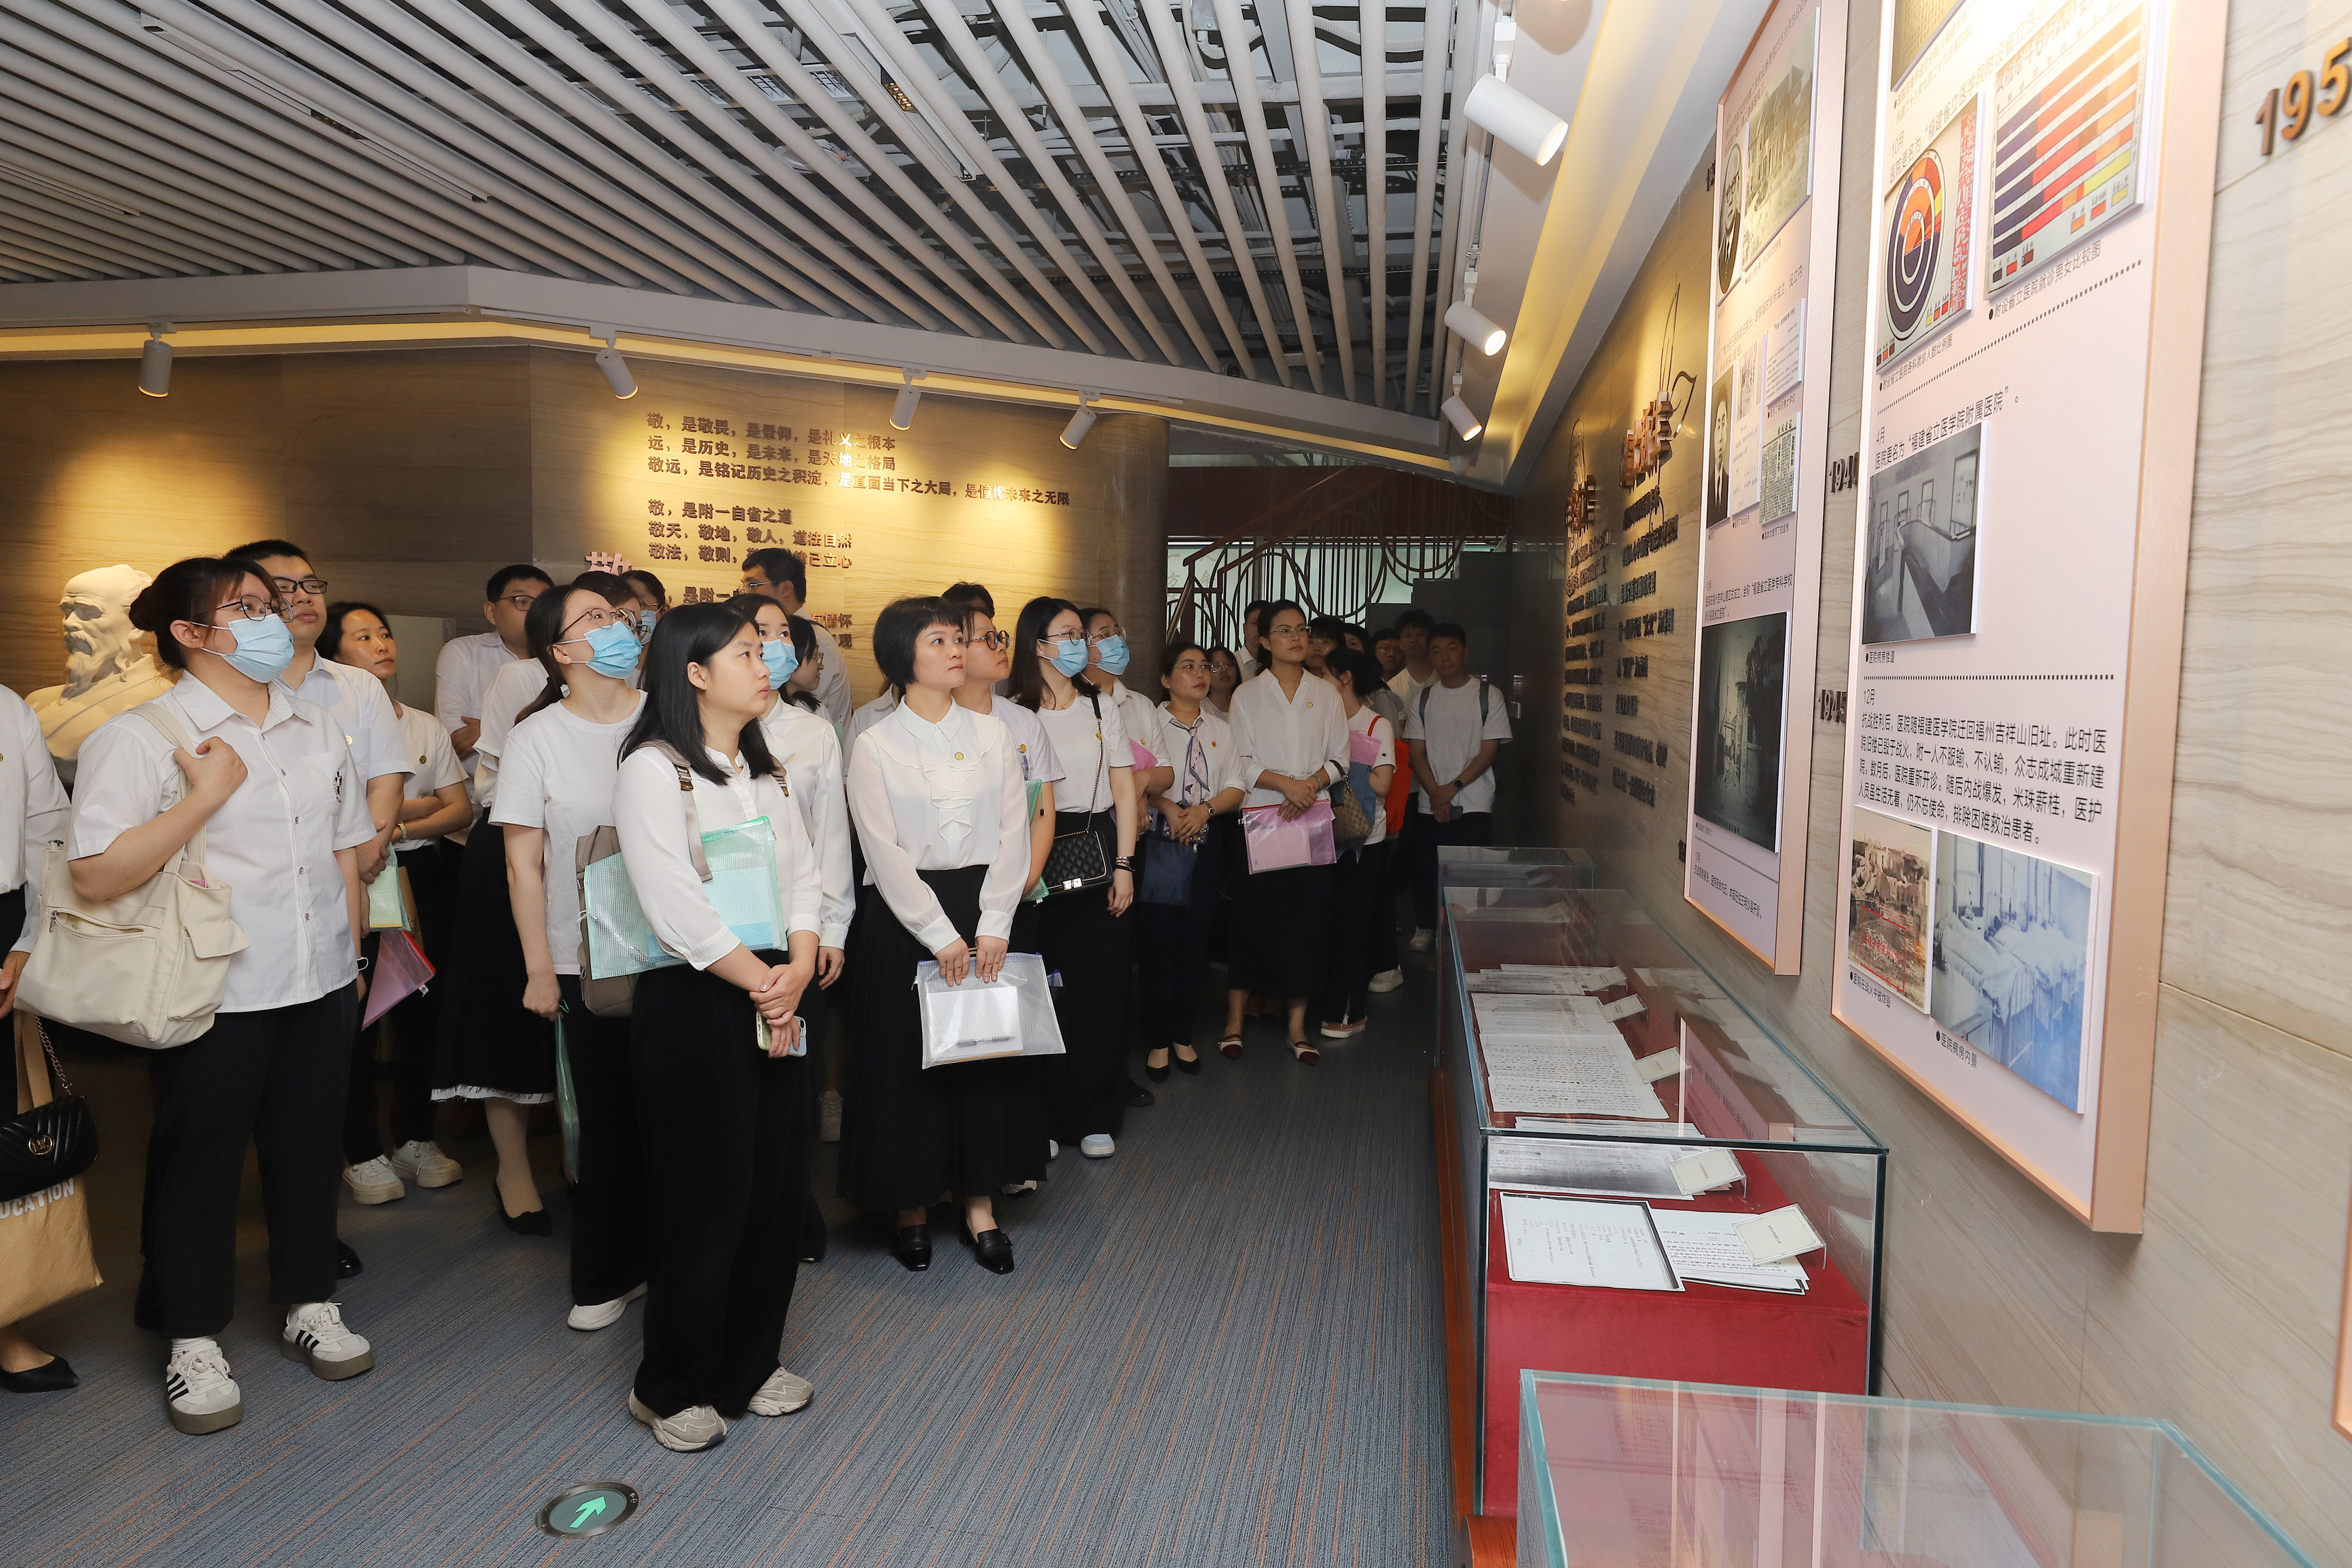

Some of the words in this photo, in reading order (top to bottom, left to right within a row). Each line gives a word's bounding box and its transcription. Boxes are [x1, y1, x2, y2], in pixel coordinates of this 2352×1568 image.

[2256, 37, 2352, 156] 195
[1892, 130, 1904, 158] 10月
[1995, 240, 2101, 320] 附设省立医院就诊男女比较图
[1883, 333, 1953, 391] 附设省立医院各科就诊人数比例图
[647, 412, 896, 451] 敬，是敬畏，是景仰，是礼义之根本
[1876, 426, 1885, 445] 4月
[647, 435, 896, 471] 远，是历史，是未来，是天地之格局
[647, 456, 1070, 505] 敬远，是铭记历史之积淀，是直面当下之大局，是憧憬未来之无限
[648, 498, 793, 526] 敬，是附一自省之道
[648, 521, 852, 549] 敬天，敬地，敬人，道法自然
[1868, 650, 1895, 664] 医院病房楼道
[1864, 689, 1875, 705] 12月
[1862, 712, 2107, 753] 抗战胜利后，医院随福建医学院迁回福州吉祥山旧址。此时医
[1860, 735, 2105, 789] 院旧楼已毁于战火，附一人不服输、不认输，众志成城重新建
[1860, 758, 2103, 824] 院。数月后，医院重新开诊。随后内战爆发，米珠薪桂，医护
[1858, 781, 2040, 845] 人员虽生活无着，仍不忘使命，排除困难救治患者。
[1853, 972, 1892, 1009] 医院在战火中被炸毁
[1940, 1032, 1978, 1070] 医院病房内景
